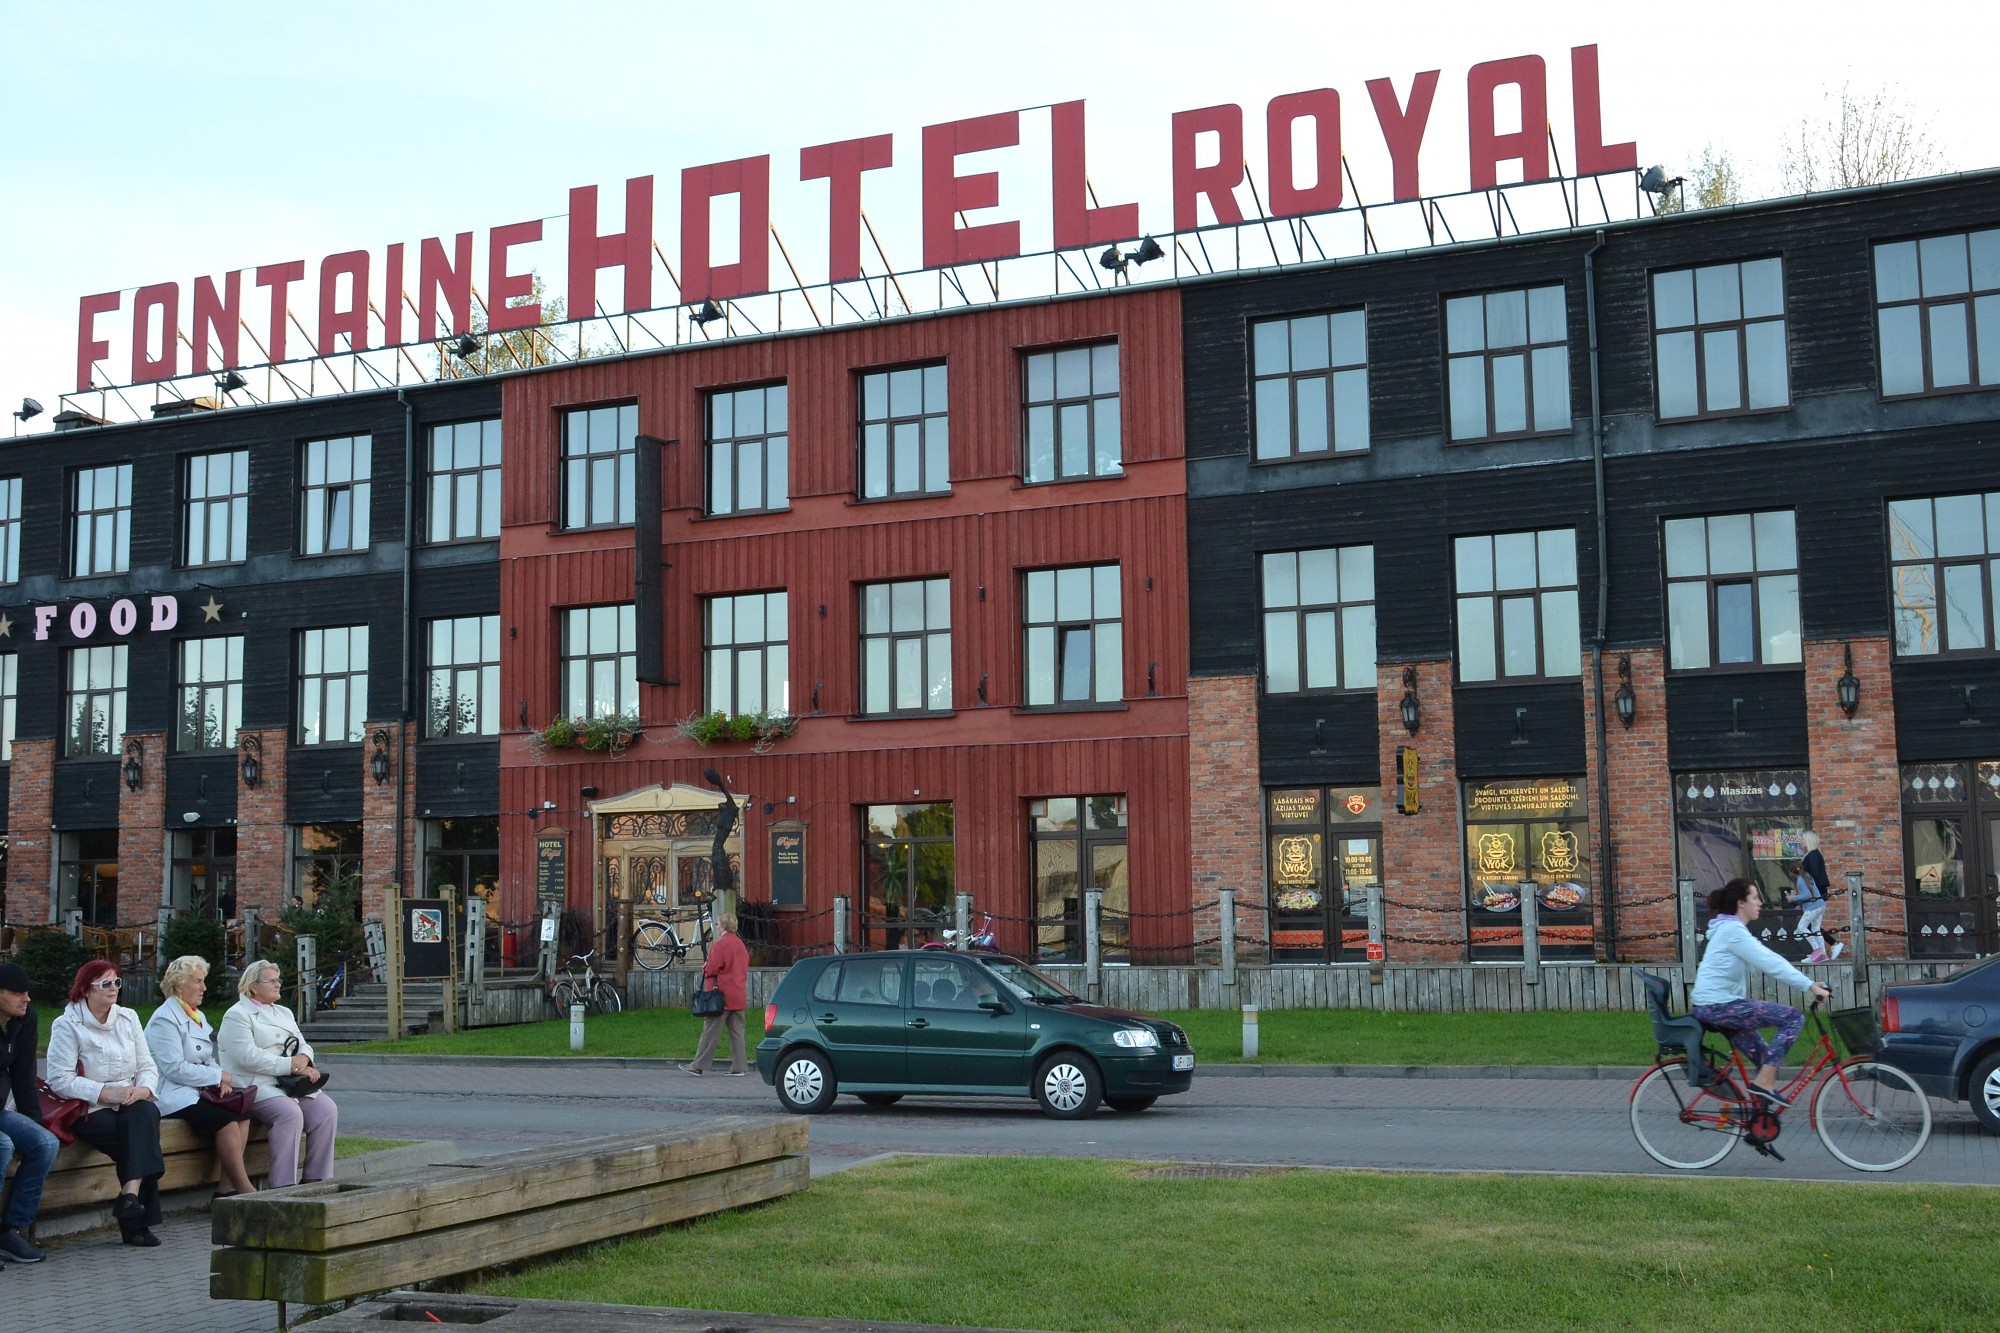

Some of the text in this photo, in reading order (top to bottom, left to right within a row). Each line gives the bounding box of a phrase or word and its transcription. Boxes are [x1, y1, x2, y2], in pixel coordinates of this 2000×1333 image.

[77, 44, 1637, 393] FONTAINE HOTEL ROYAL
[34, 595, 179, 641] FOOD
[1500, 787, 1538, 796] KONSERVĒTI
[1550, 785, 1576, 793] SALDĒTI
[1720, 785, 1763, 795] Masāžas
[1481, 803, 1511, 811] VIRTUVES
[1513, 802, 1547, 810] SAMURAJU
[1284, 861, 1308, 872] WOK
[1483, 857, 1510, 869] WOK
[1547, 855, 1574, 867] WOK
